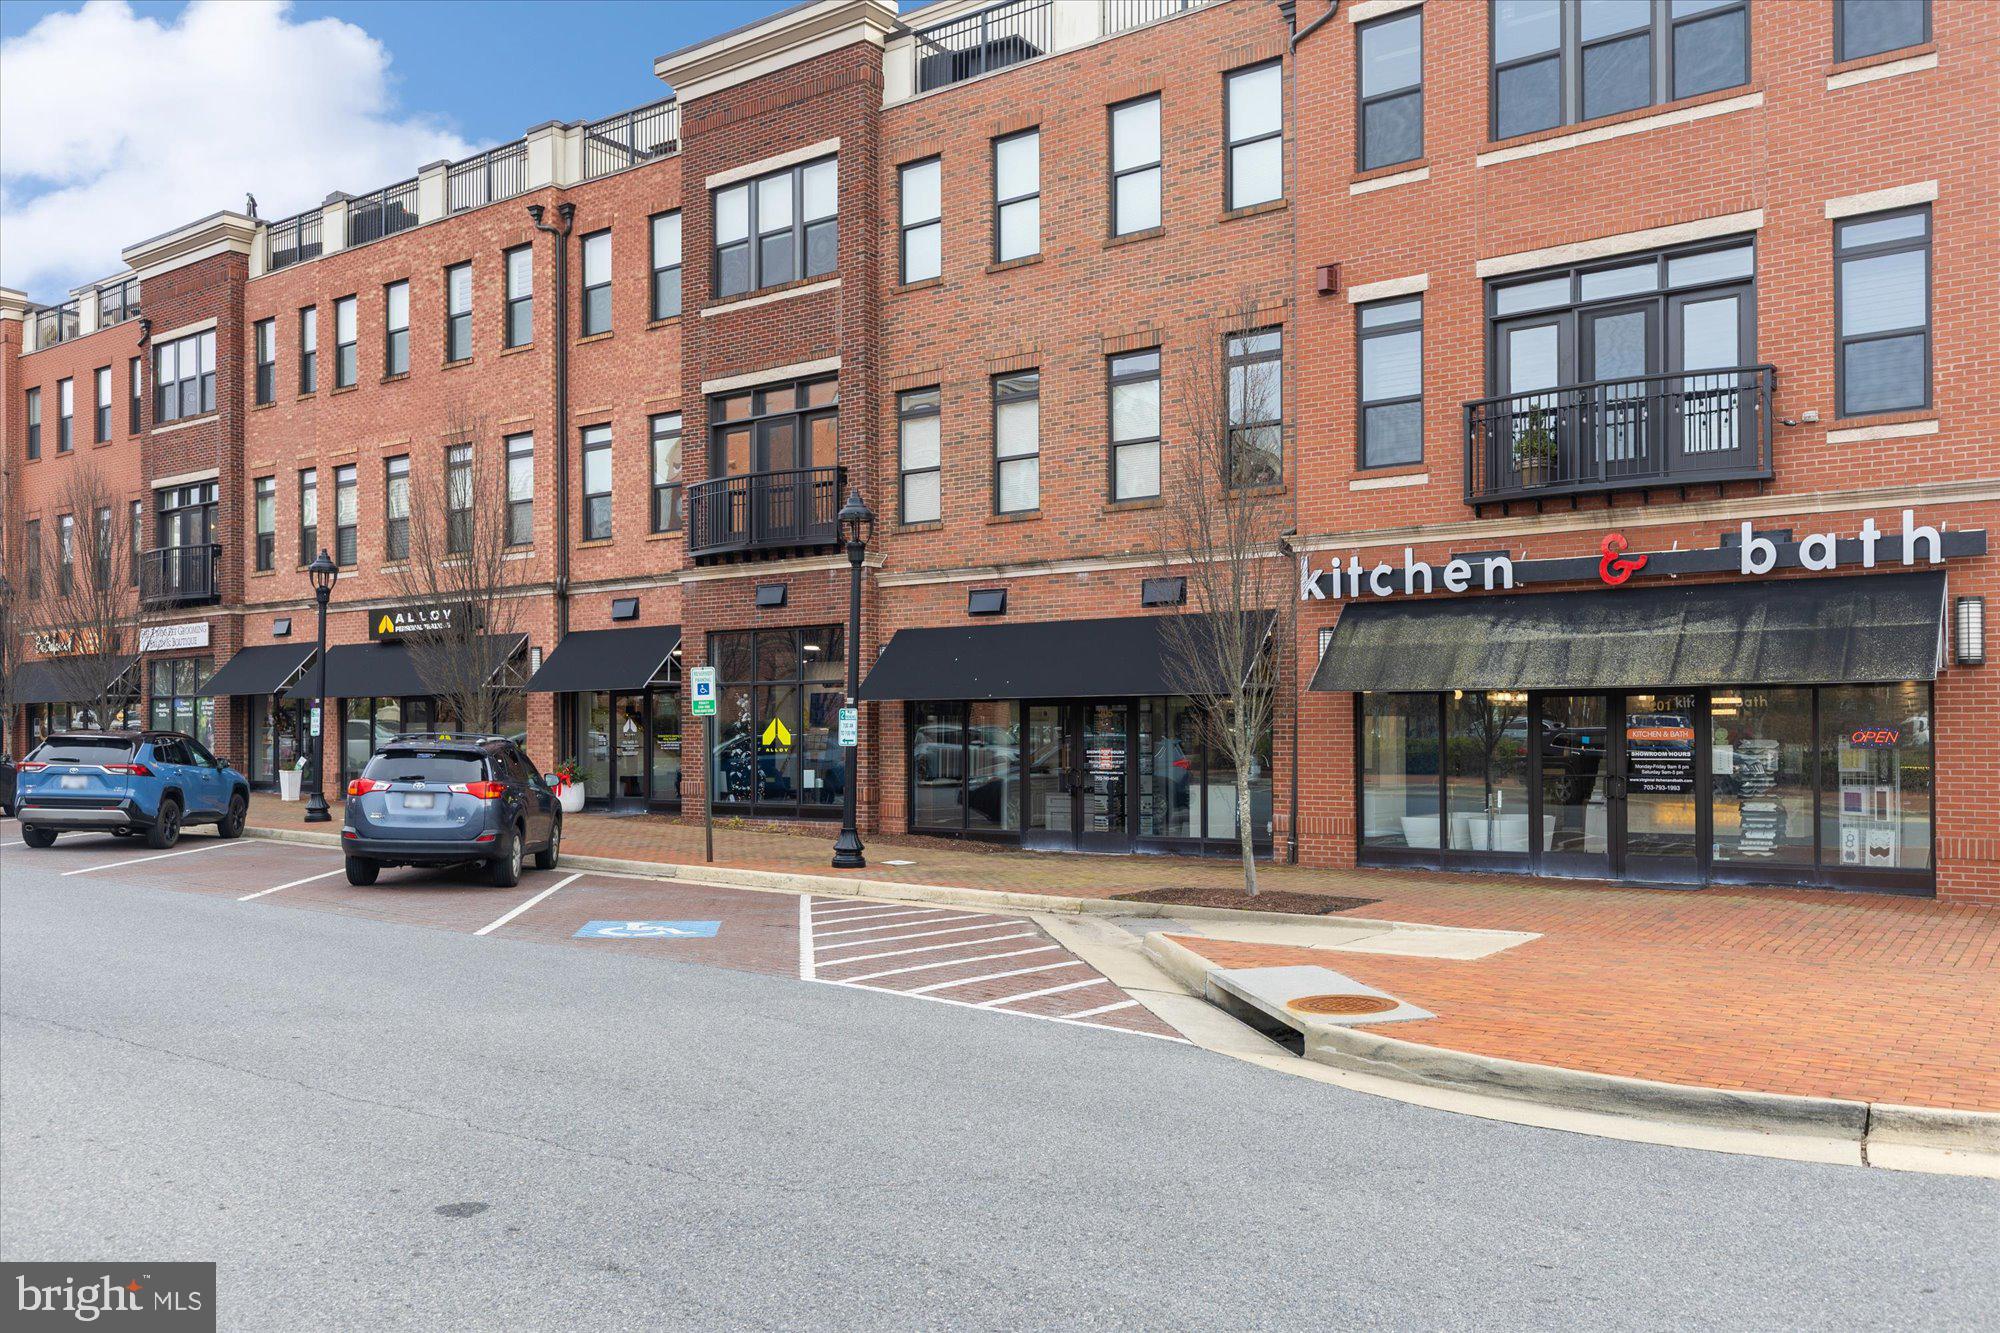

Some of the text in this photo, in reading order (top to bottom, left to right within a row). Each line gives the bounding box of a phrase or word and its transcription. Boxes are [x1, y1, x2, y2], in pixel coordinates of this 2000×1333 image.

[1301, 509, 1941, 600] kitchen & bath
[395, 609, 451, 624] ALLOY
[1649, 701, 1671, 711] 201
[841, 710, 845, 720] 2
[1852, 731, 1899, 742] OPEN
